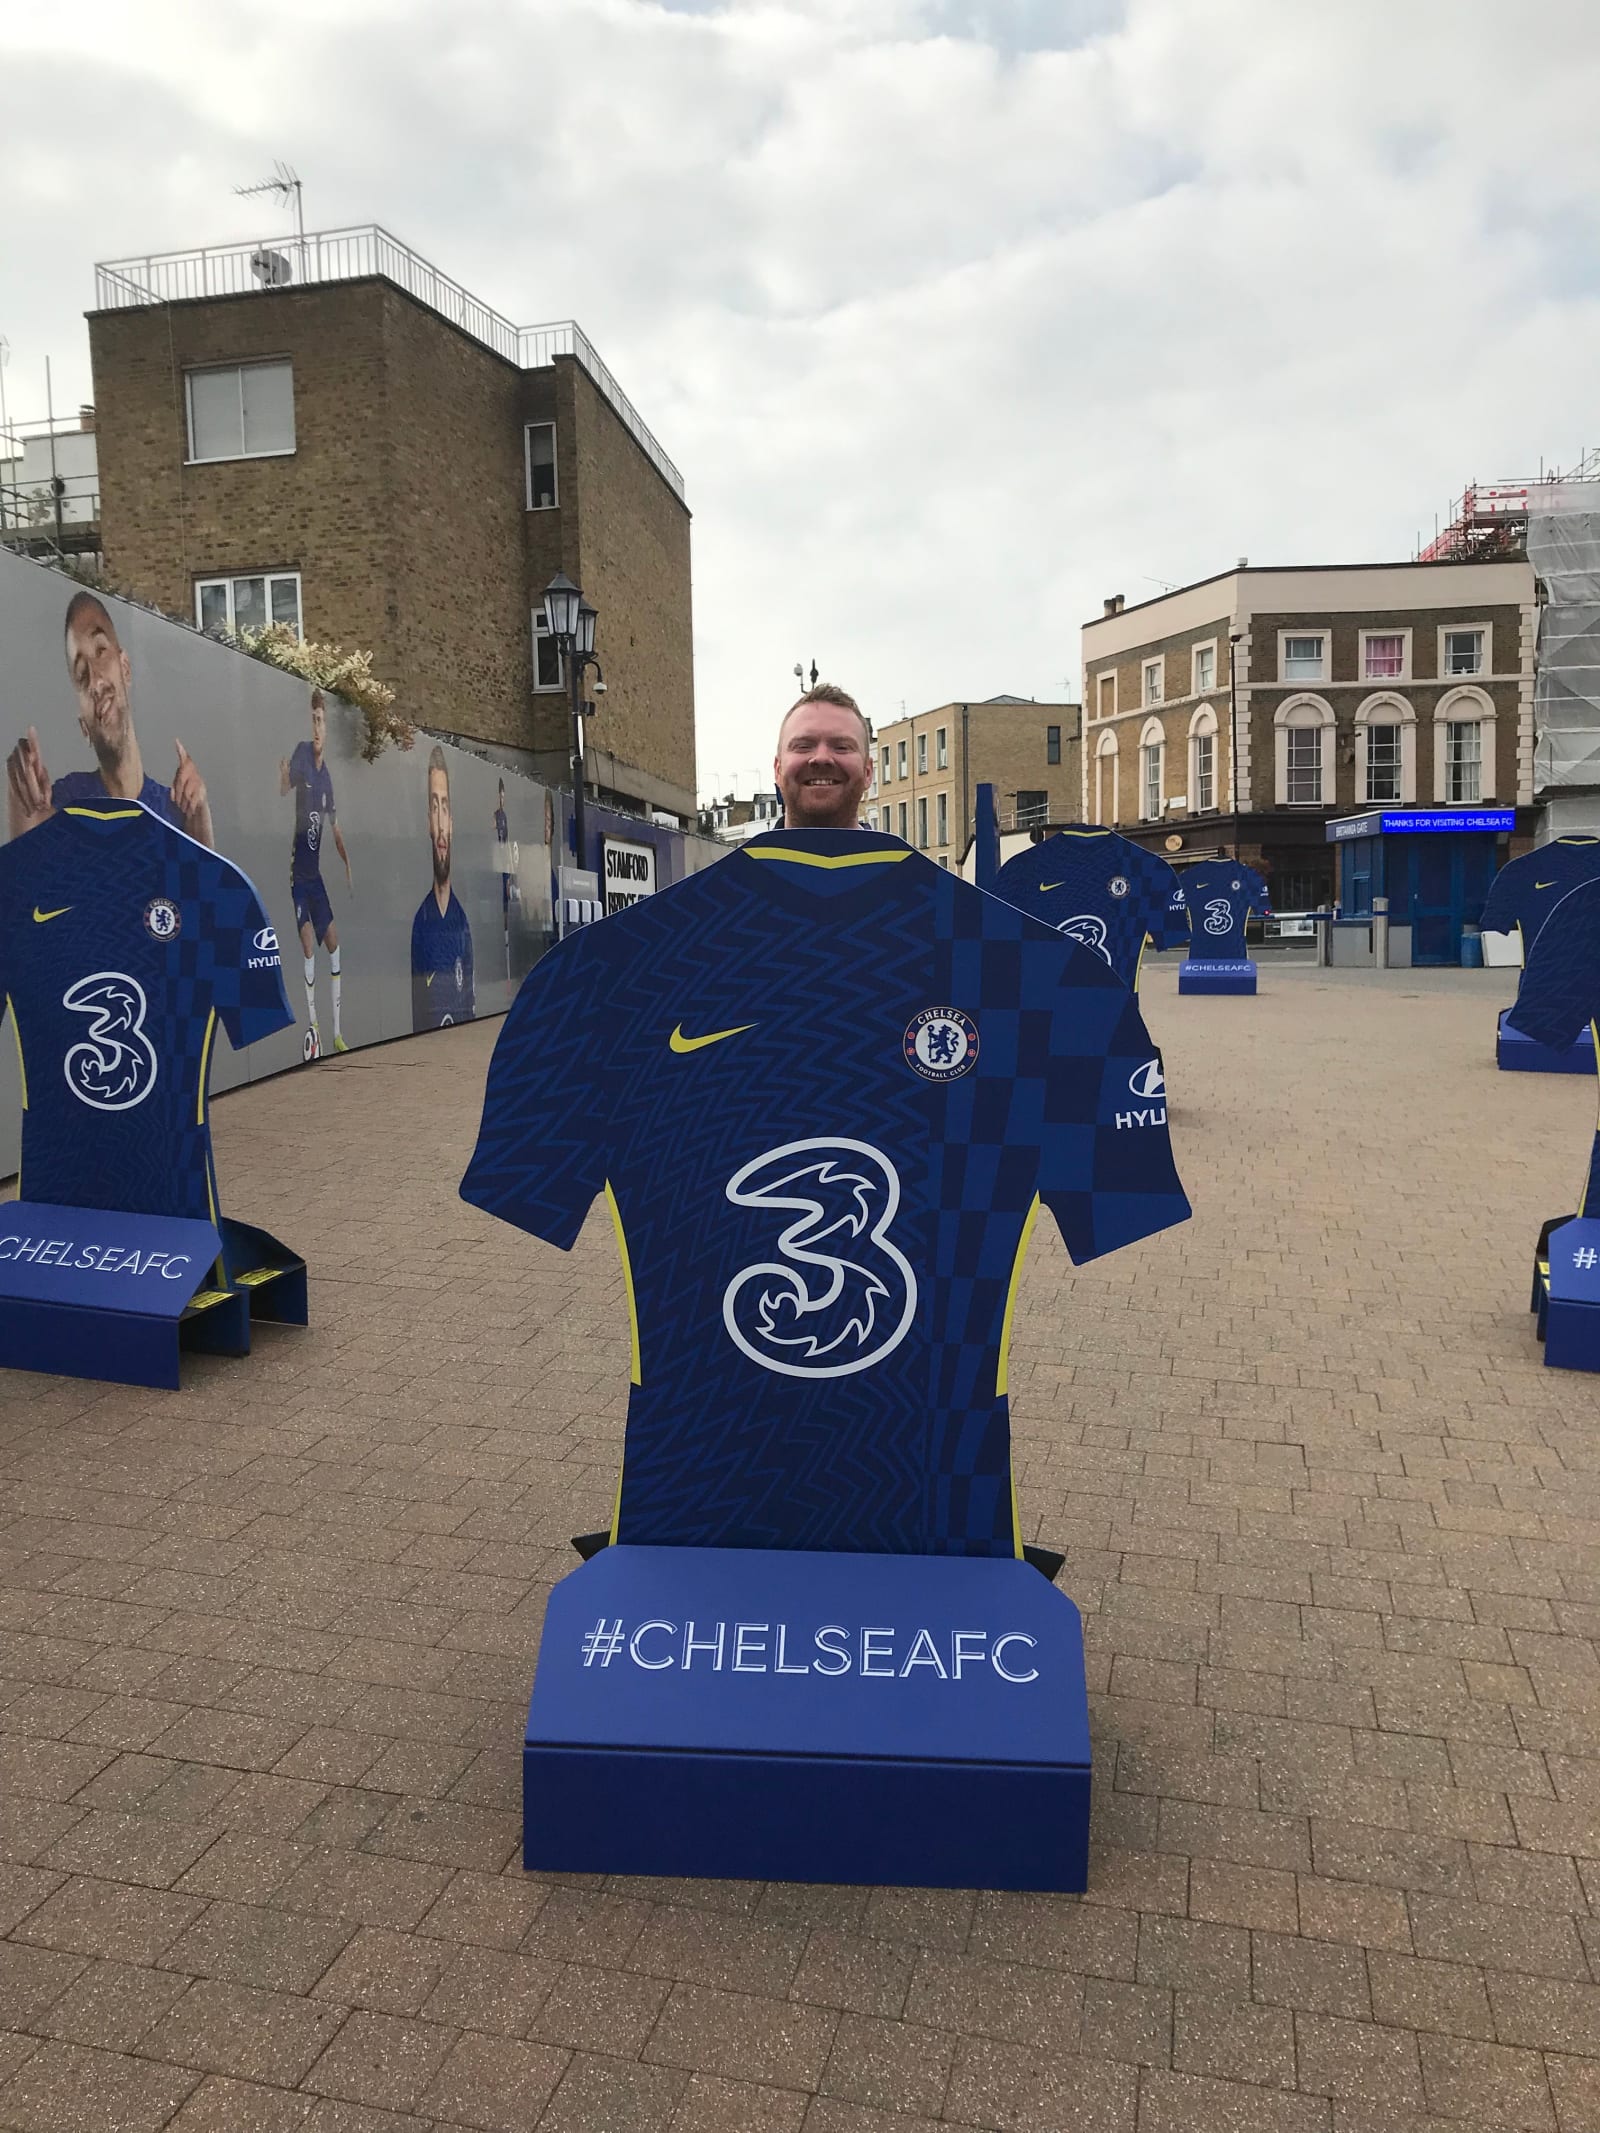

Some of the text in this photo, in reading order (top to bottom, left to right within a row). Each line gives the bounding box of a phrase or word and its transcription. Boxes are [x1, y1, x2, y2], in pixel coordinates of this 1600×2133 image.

[1357, 821, 1368, 834] GATE
[1383, 817, 1513, 828] THANKS FOR VISITING CHELSEA FC
[606, 848, 648, 882] STAMFORD
[1203, 898, 1234, 936] 3
[1185, 963, 1252, 972] #CHELSEAFC
[917, 1008, 966, 1027] CHELSEA
[915, 1062, 967, 1078] FOOTBALL CLUB
[1115, 1107, 1167, 1130] HYU
[722, 1136, 918, 1379] 3
[581, 1618, 1040, 1684] #CHELSEAFC
